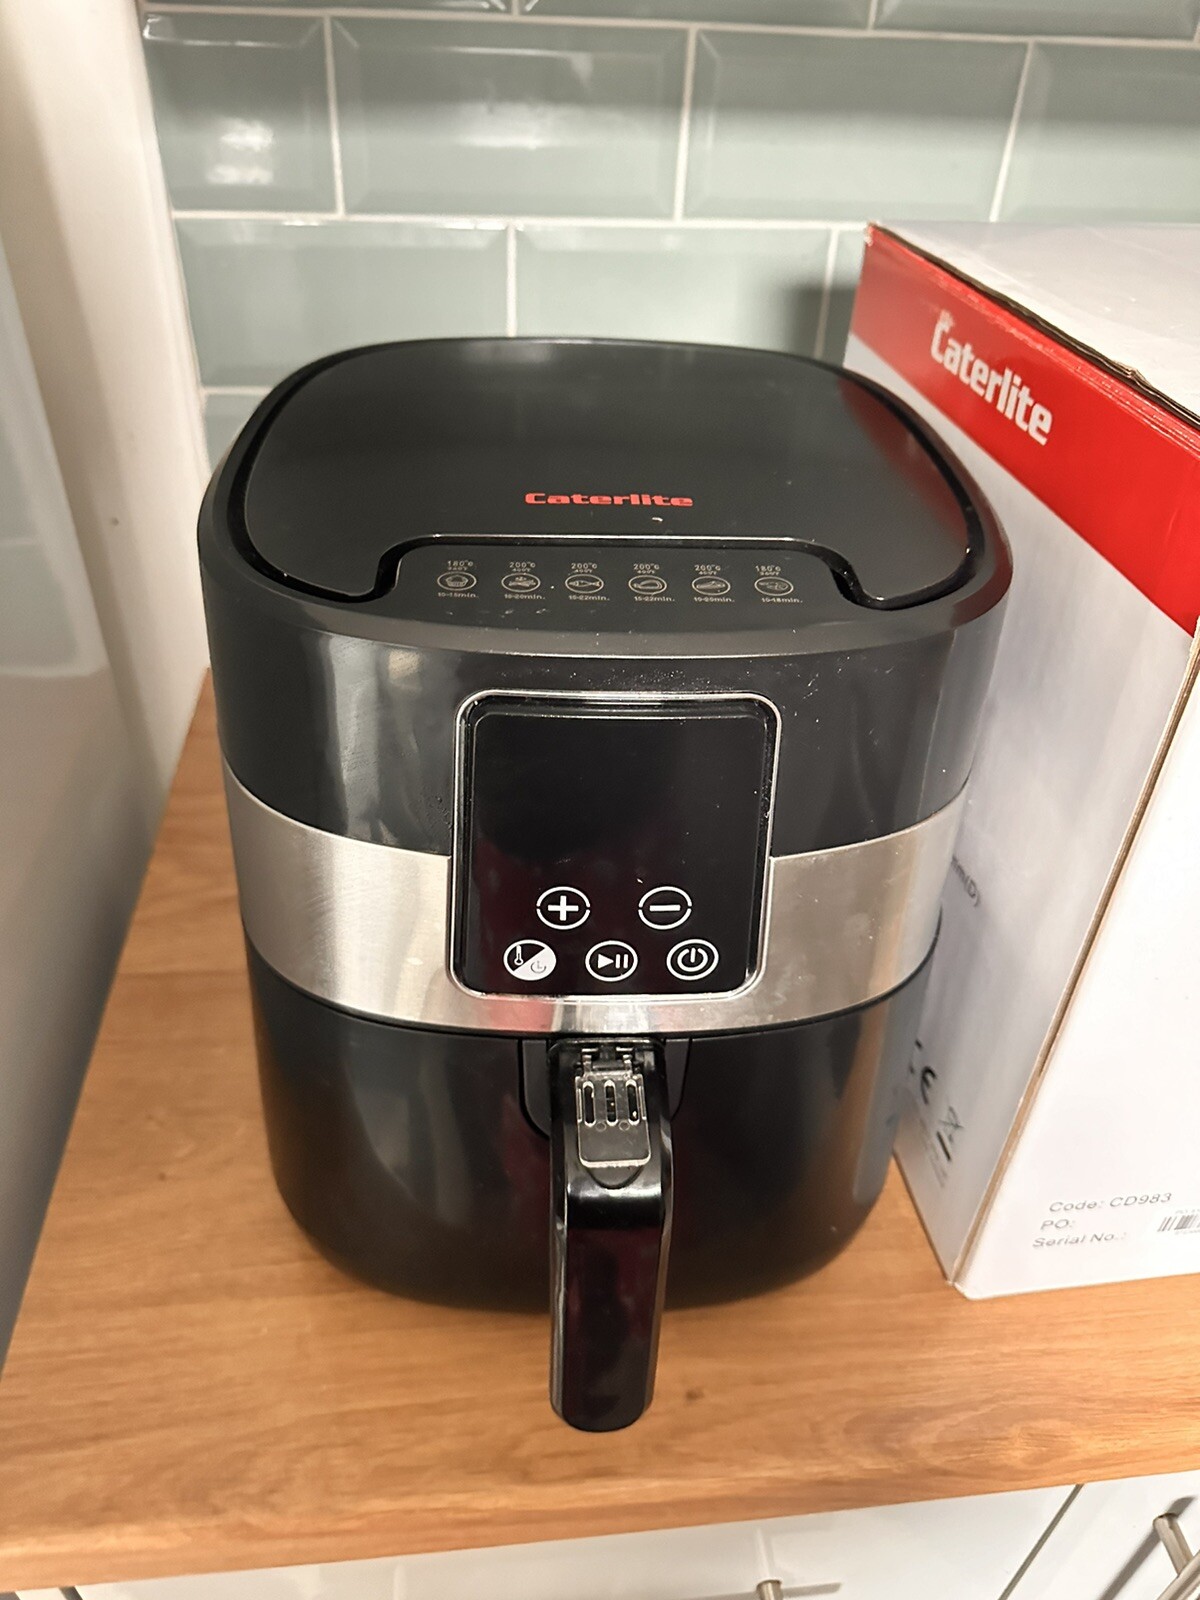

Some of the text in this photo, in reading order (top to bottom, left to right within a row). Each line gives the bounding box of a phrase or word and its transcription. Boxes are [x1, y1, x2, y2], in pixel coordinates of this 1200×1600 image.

[929, 310, 1053, 446] Caterlite
[525, 492, 694, 507] Caterlite
[1049, 1192, 1172, 1212] Code: CD983
[1040, 1218, 1076, 1231] PO:
[1032, 1234, 1087, 1248] Serial
